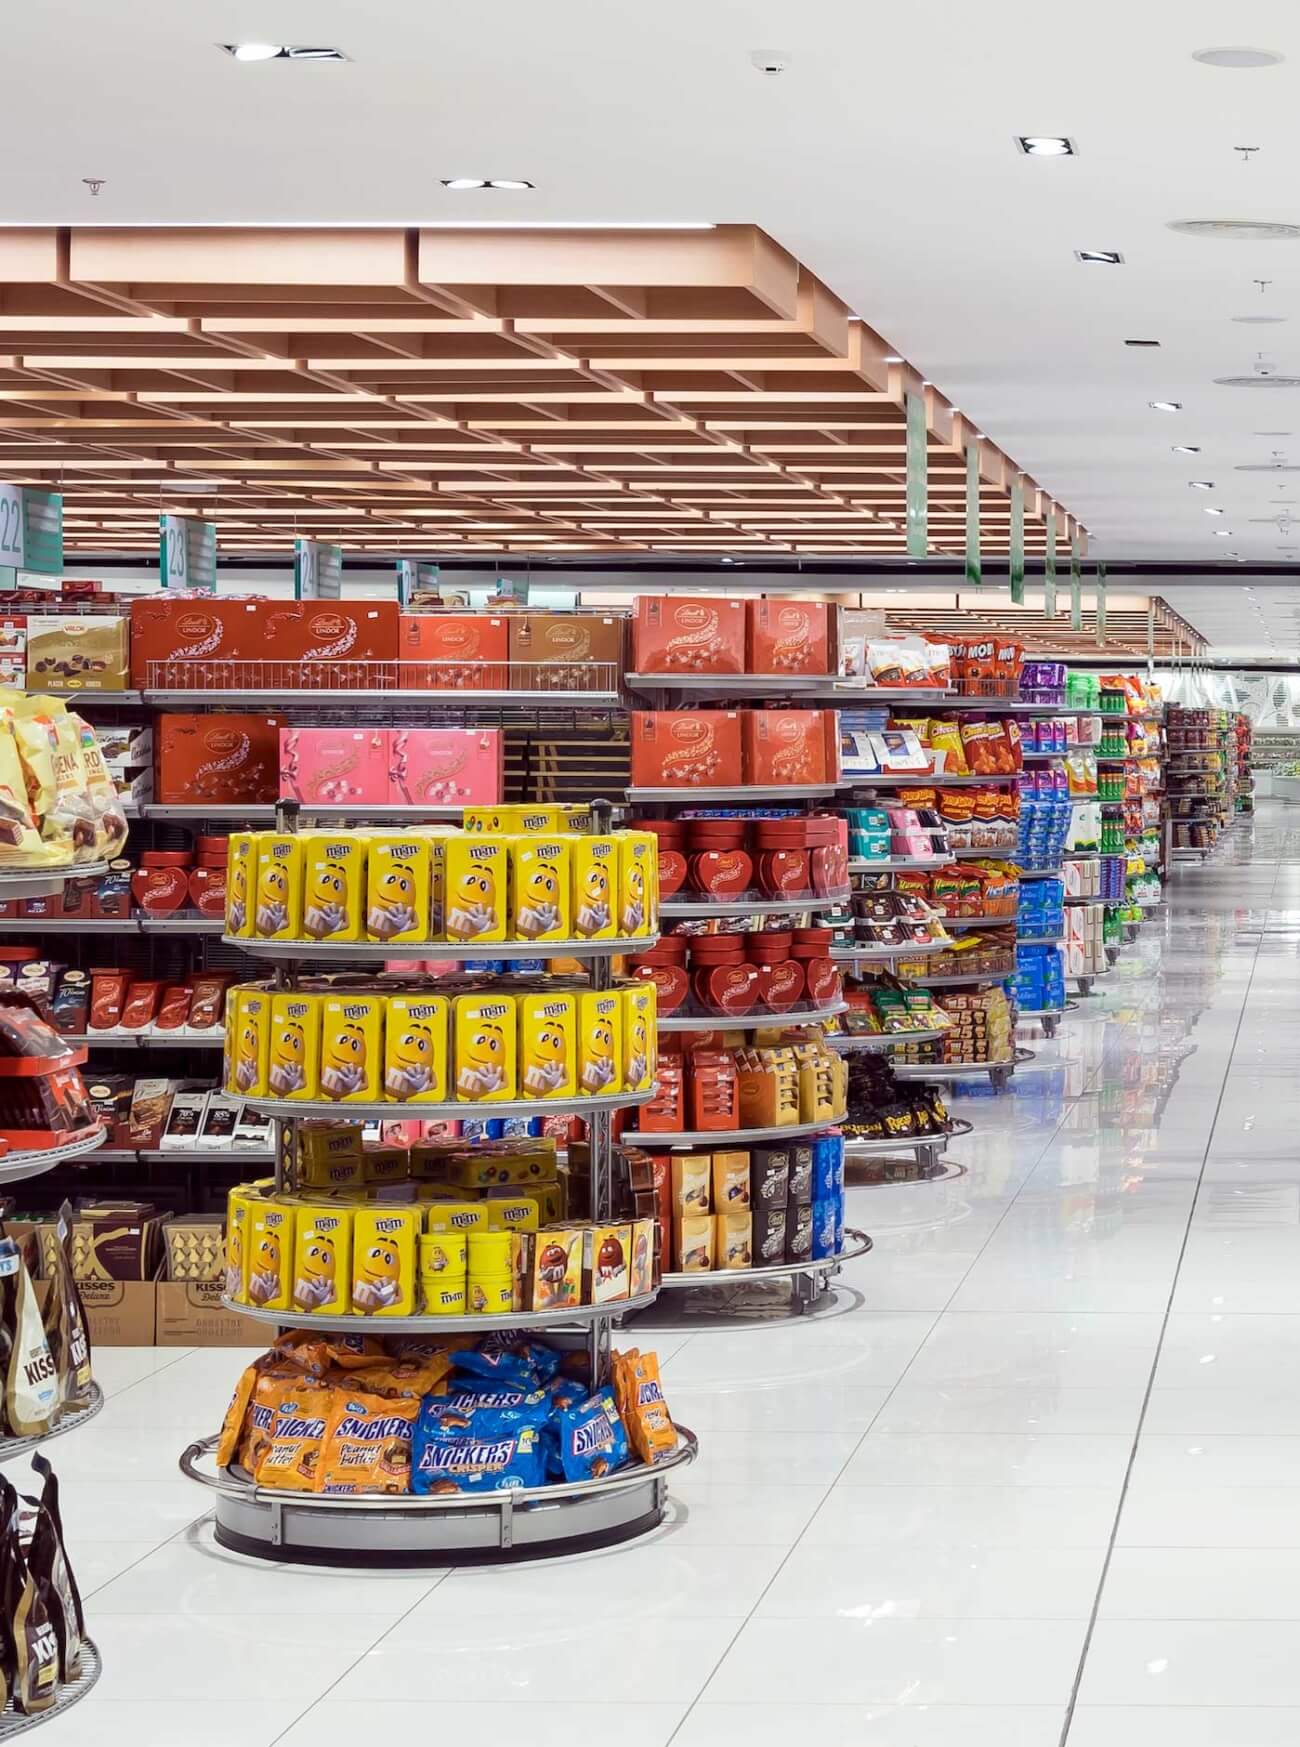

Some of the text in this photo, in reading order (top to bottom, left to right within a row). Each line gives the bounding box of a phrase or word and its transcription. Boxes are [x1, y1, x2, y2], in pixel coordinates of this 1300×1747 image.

[1, 498, 21, 552] 22
[169, 528, 185, 577] 23
[336, 1417, 413, 1441] SNICKERS
[341, 1443, 382, 1455] Peanut
[420, 1440, 515, 1468] SNICKERS
